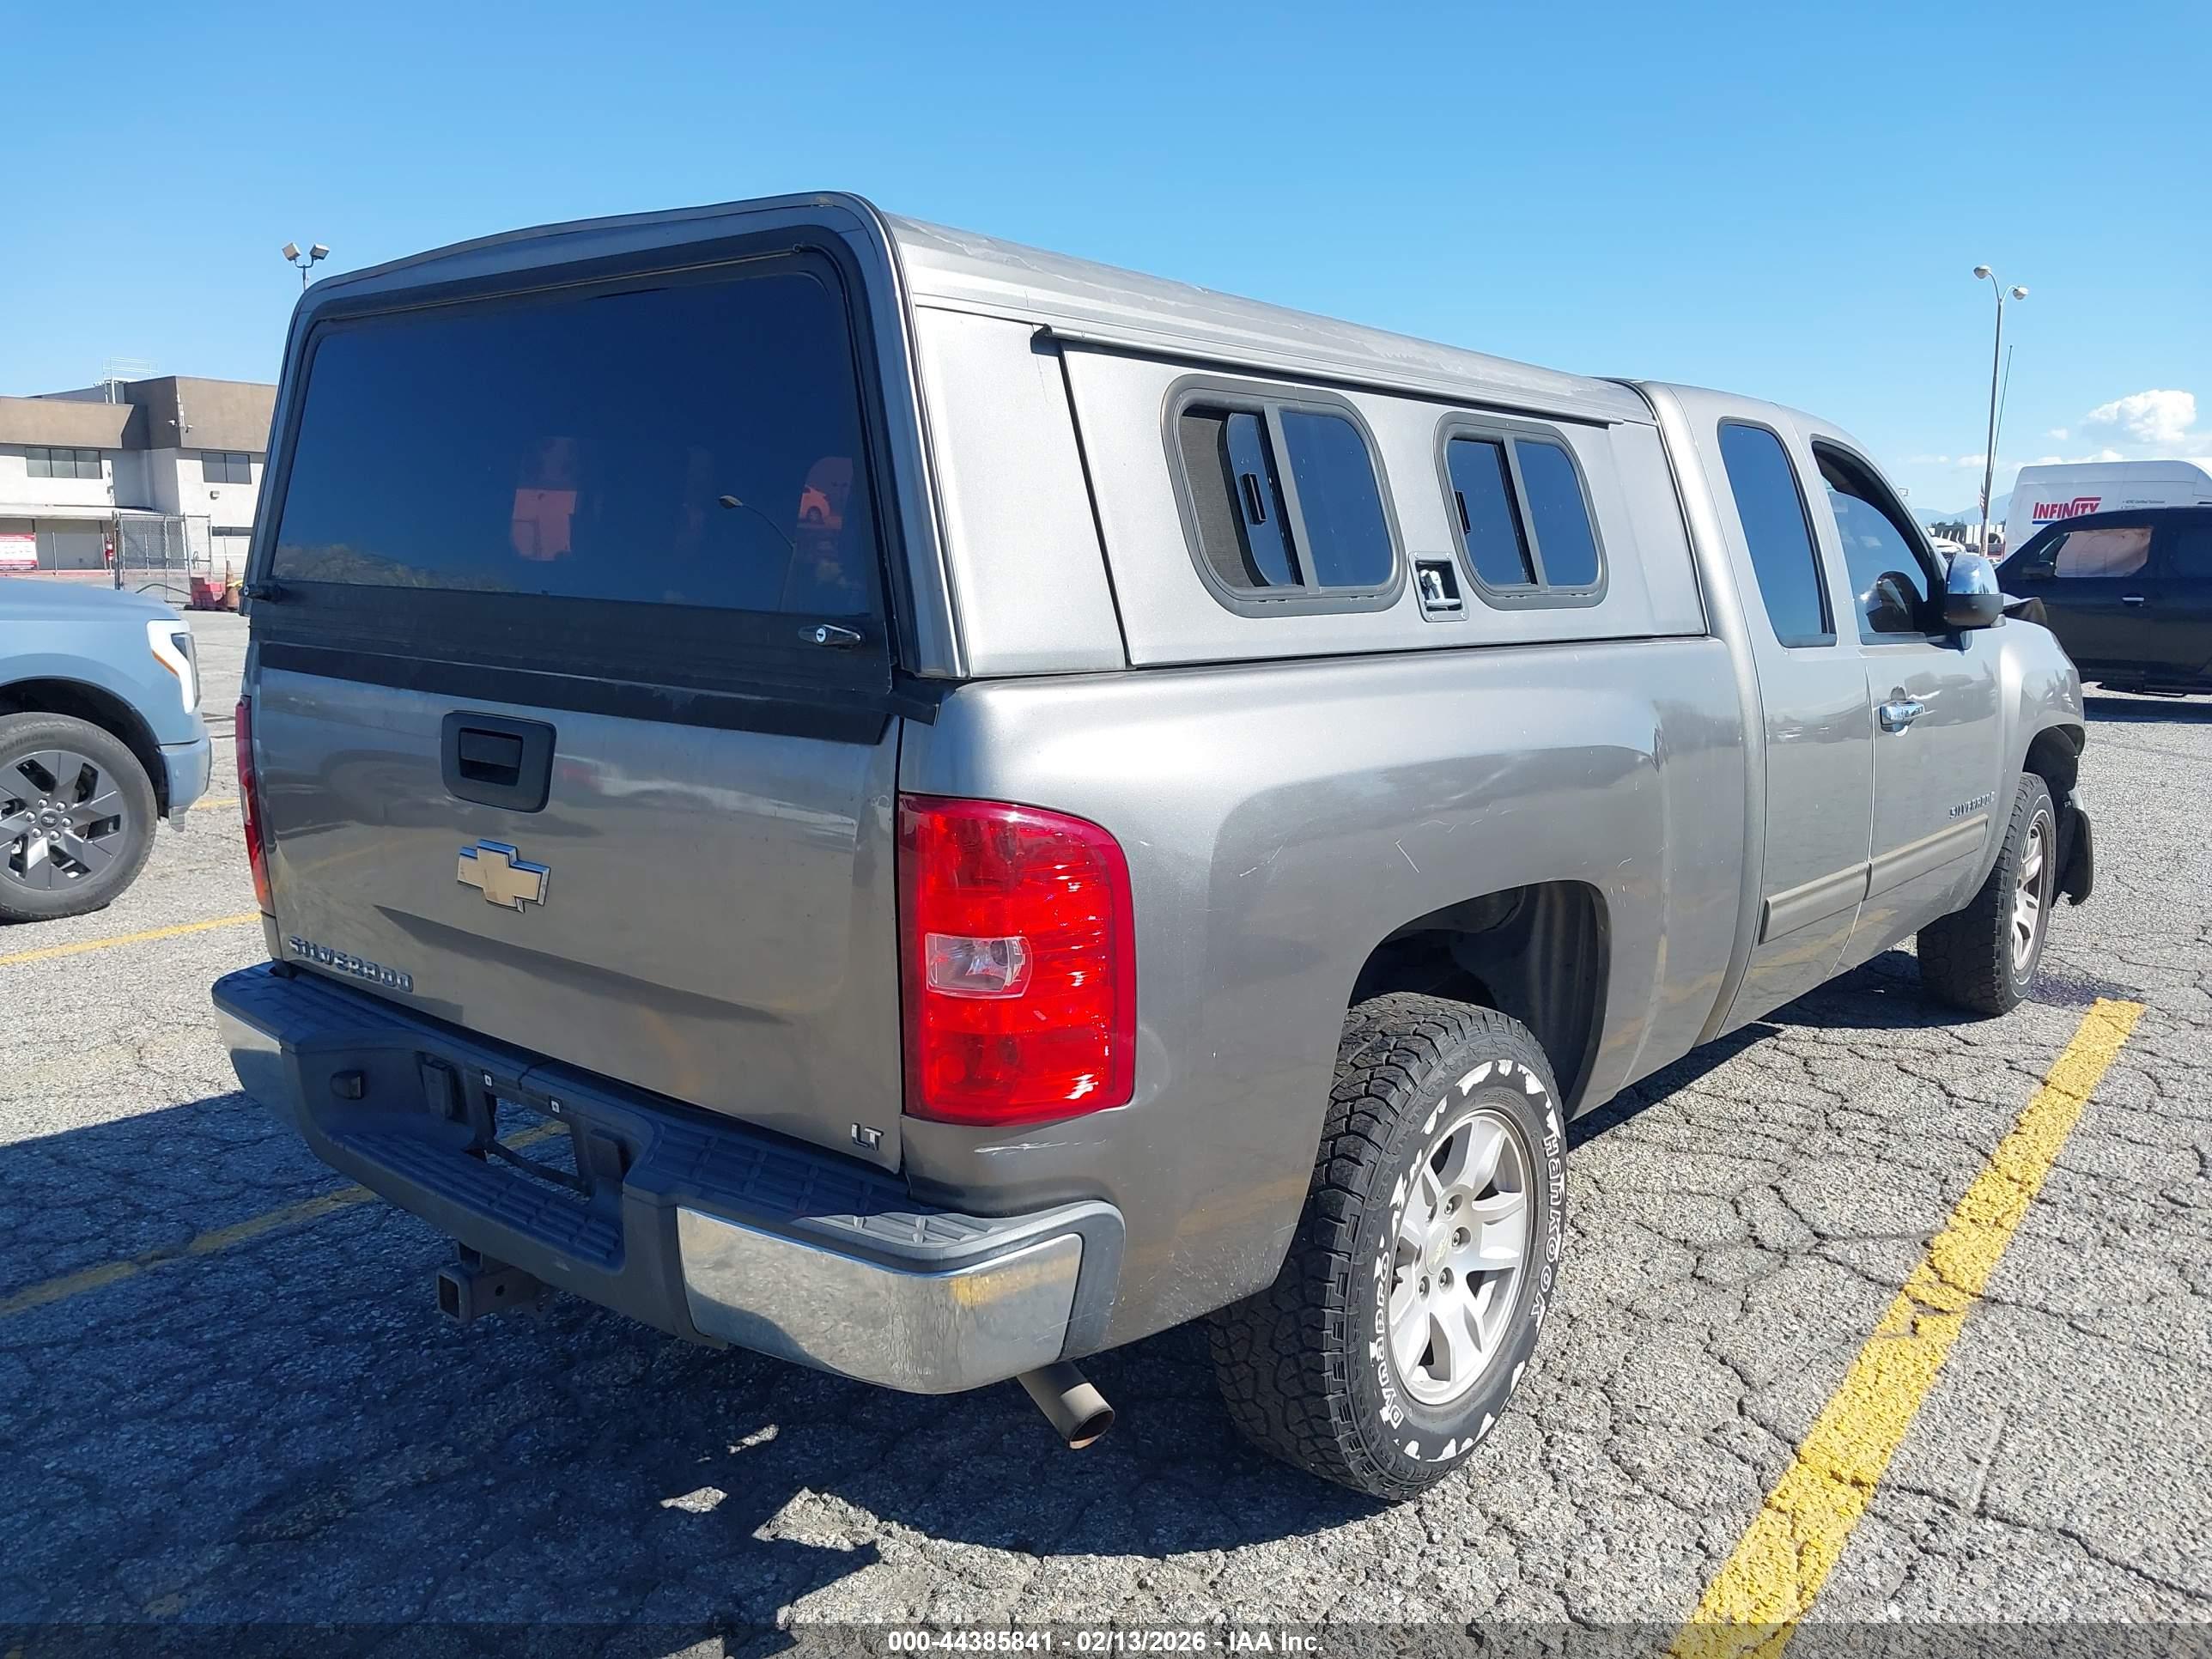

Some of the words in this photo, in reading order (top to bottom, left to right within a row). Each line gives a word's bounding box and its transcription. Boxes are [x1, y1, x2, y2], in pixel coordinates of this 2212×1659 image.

[2033, 496, 2102, 520] INFINITY
[1948, 791, 1996, 819] SILVERADO
[289, 935, 414, 993] SILVERADO
[851, 1122, 884, 1152] LT
